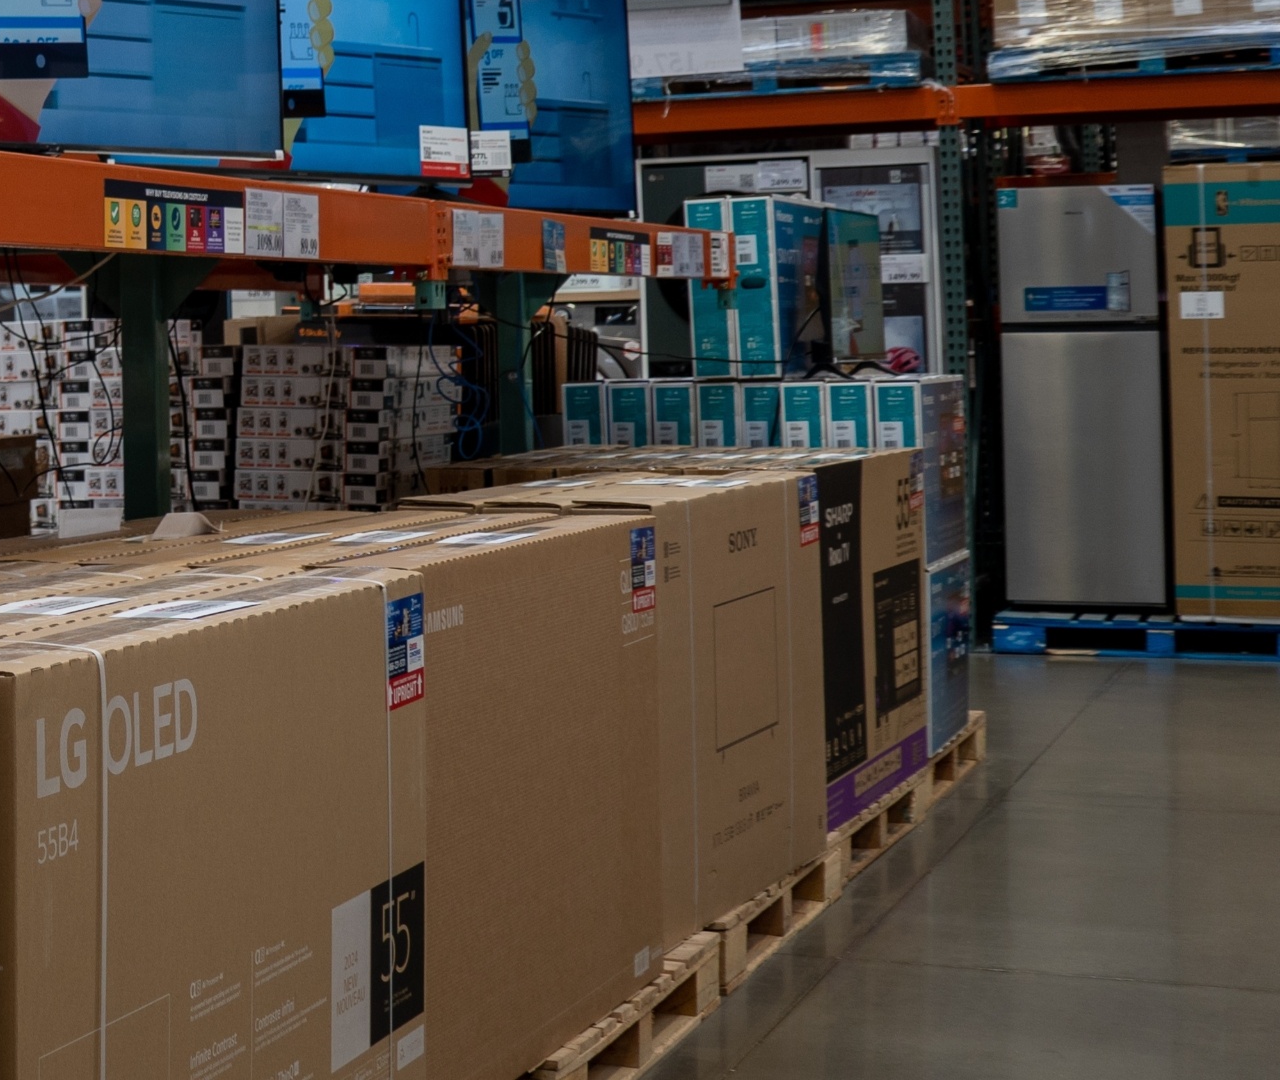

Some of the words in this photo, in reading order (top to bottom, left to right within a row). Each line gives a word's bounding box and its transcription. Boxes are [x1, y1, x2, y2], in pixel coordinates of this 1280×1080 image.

[824, 503, 854, 528] SHARP
[728, 527, 758, 554] SONY
[393, 680, 417, 704] UPRIGHT
[36, 707, 88, 799] LG
[102, 677, 198, 776] OLED
[36, 818, 79, 866] 55B4
[344, 950, 358, 970] 2024
[344, 972, 359, 990] NEW
[336, 989, 366, 1017] NOUVEAU
[190, 1045, 211, 1071] Infinite
[212, 1033, 238, 1057] Contrast
